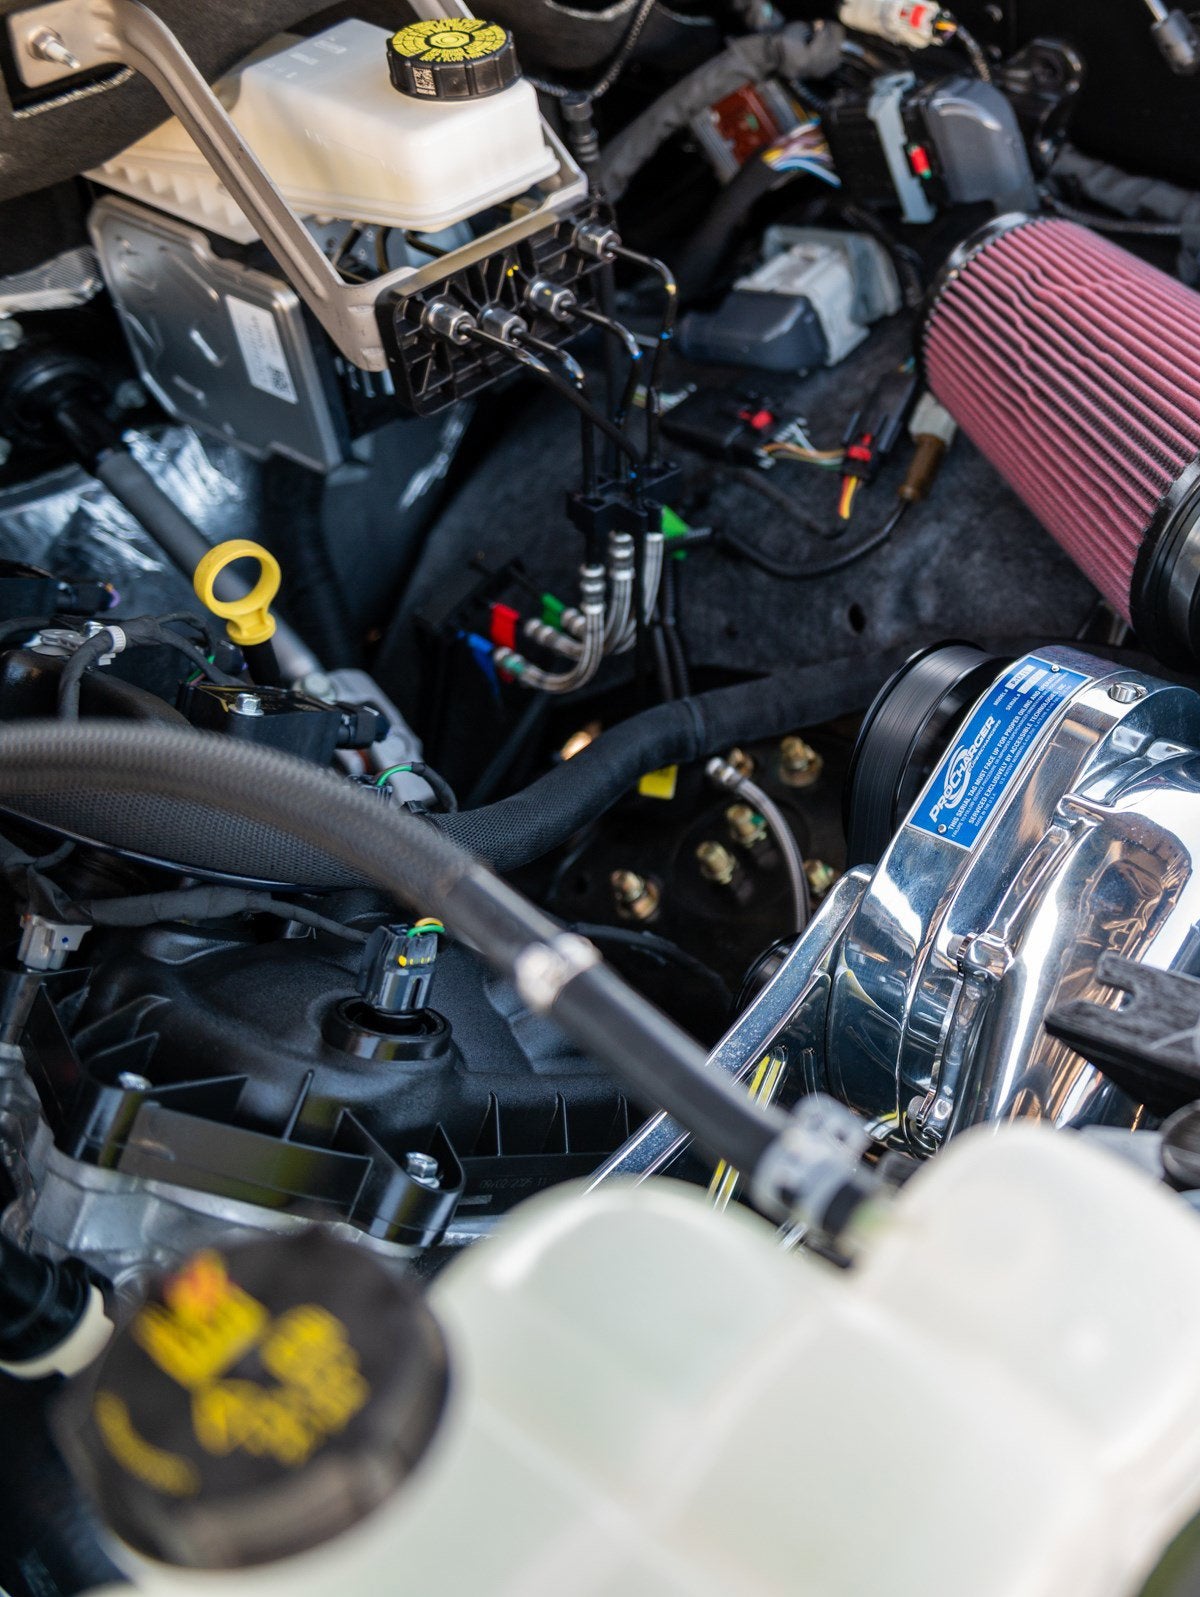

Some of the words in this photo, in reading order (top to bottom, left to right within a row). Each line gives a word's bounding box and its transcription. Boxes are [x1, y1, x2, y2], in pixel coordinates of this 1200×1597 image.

[929, 715, 995, 823] PROCHARGER
[948, 815, 960, 830] THIS
[955, 796, 971, 817] SERIAL
[967, 785, 977, 796] TAG
[974, 769, 987, 786] MUST
[983, 754, 995, 770] FACE
[991, 746, 1000, 756] UP
[996, 735, 1007, 747] FOR
[1003, 714, 1021, 736] PROPER
[1029, 689, 1041, 700] AND
[968, 796, 987, 824] SERVICED
[983, 761, 1008, 797] EXCLUSIVELY
[1004, 753, 1013, 761] BY
[1009, 722, 1032, 754] ACCESSIBLE
